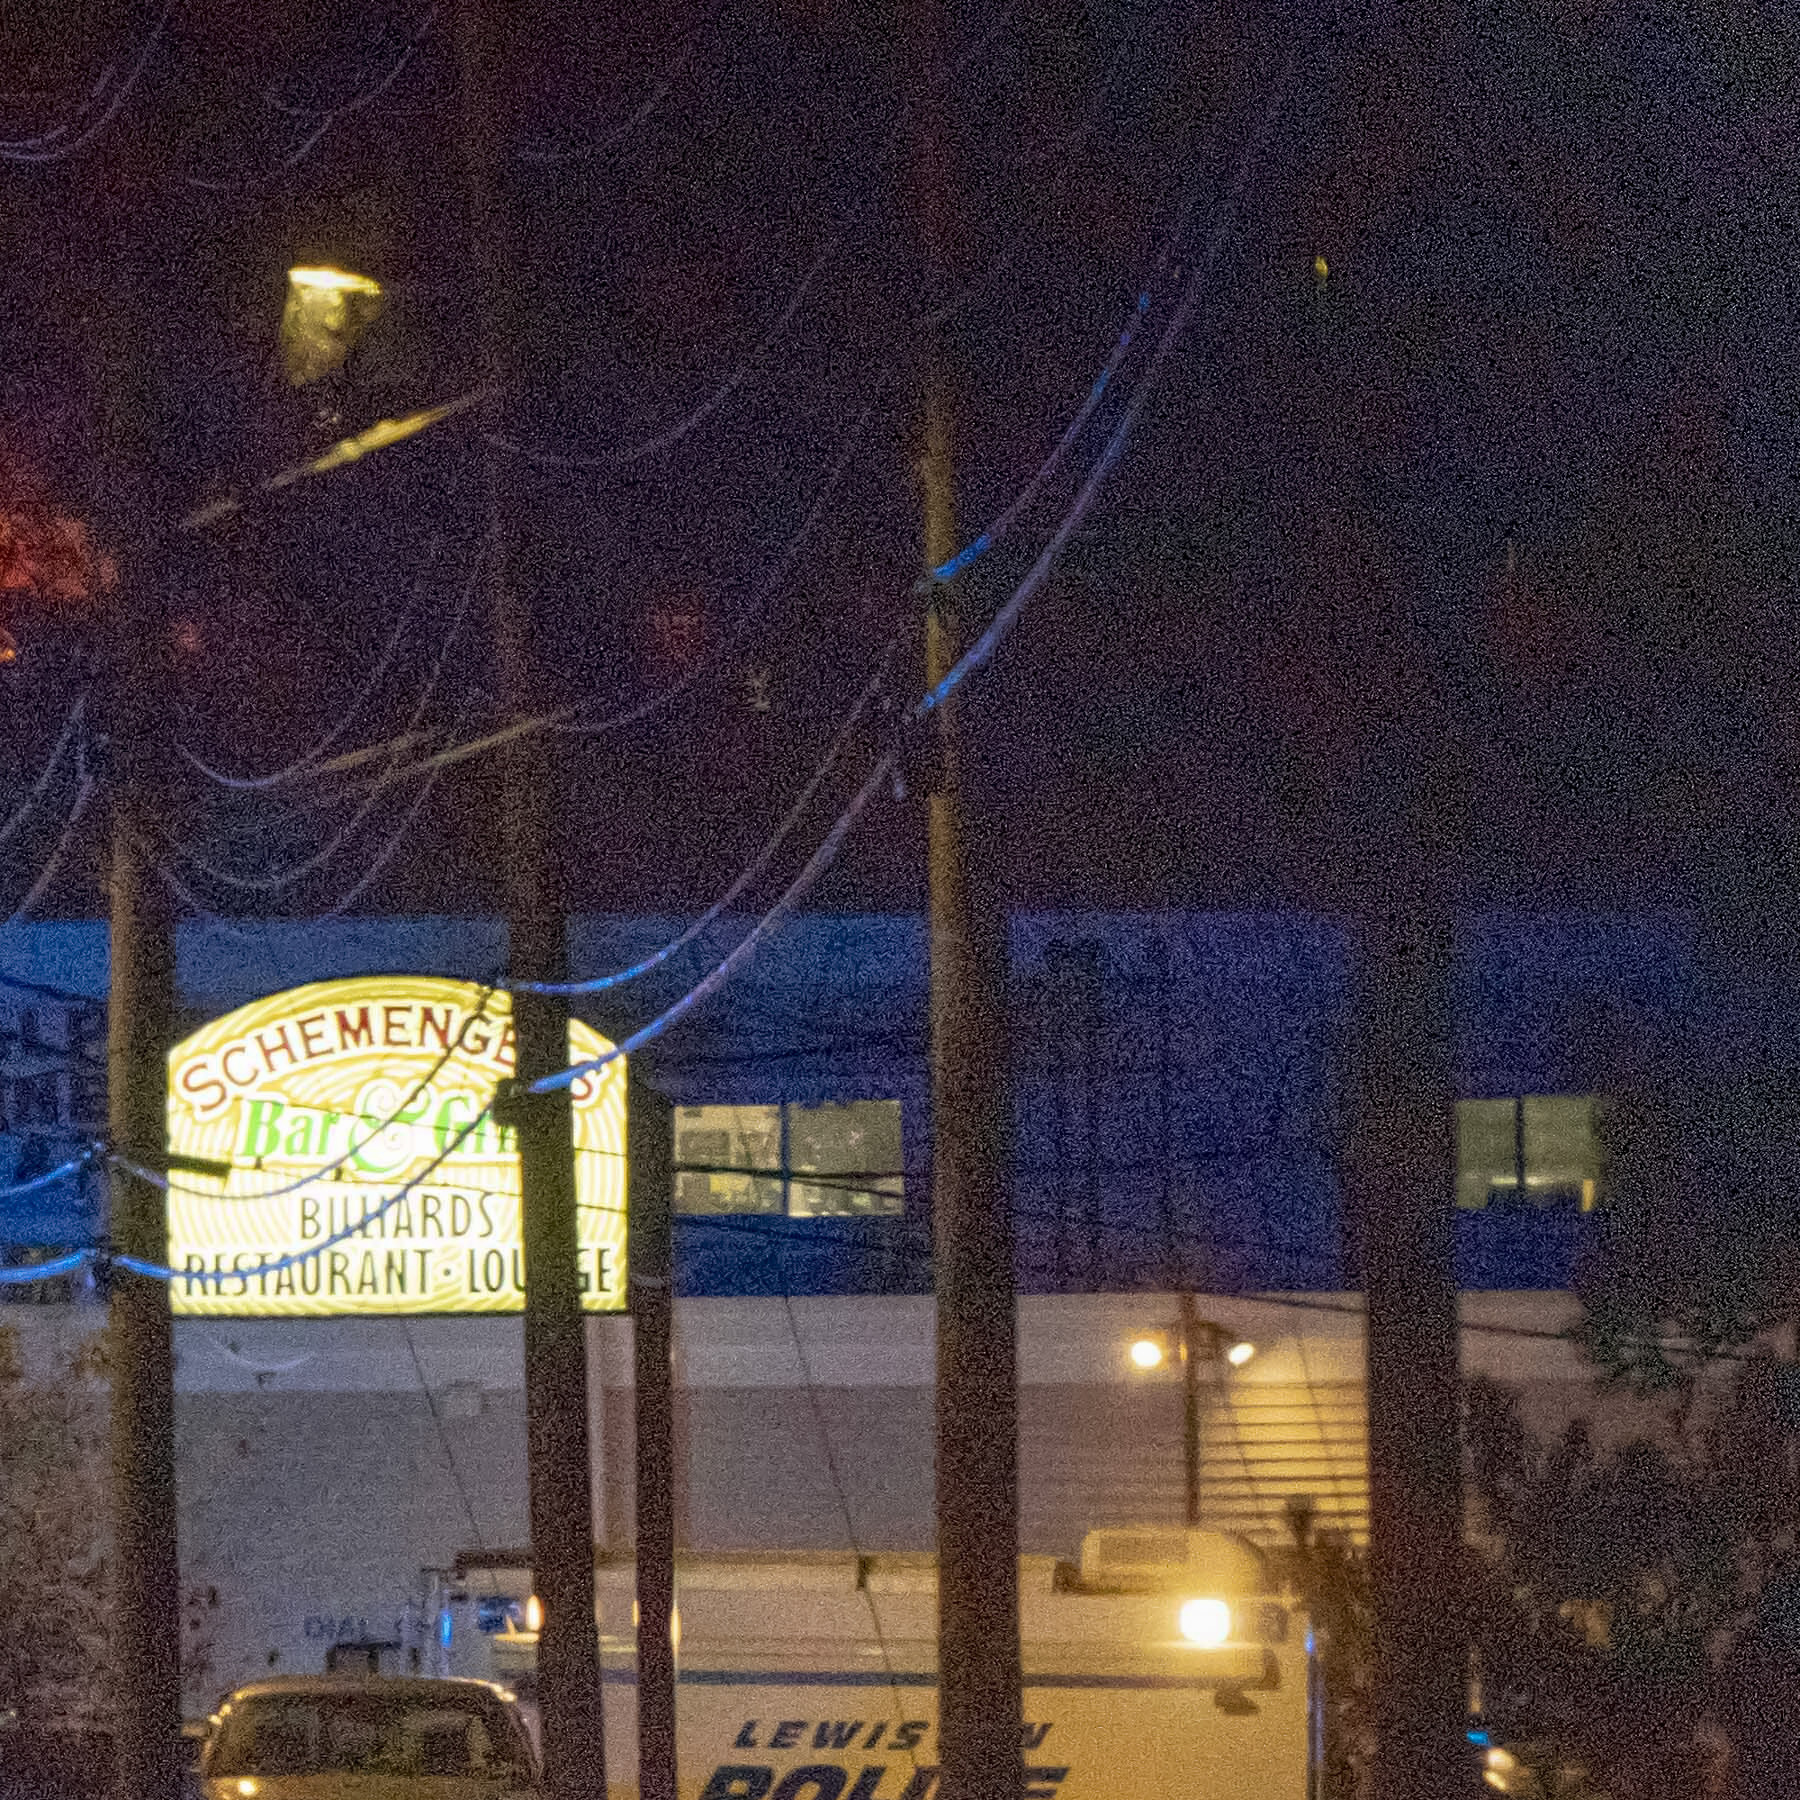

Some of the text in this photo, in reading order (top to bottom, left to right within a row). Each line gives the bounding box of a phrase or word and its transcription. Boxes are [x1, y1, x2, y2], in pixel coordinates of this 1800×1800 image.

[182, 1005, 593, 1111] SCHEMENGES
[241, 1097, 341, 1158] Bar
[348, 1081, 431, 1172] &
[301, 1193, 495, 1240] BILLIARDS
[184, 1247, 612, 1297] RESTAURANT LOUGE
[734, 1719, 1053, 1750] LEWISN
